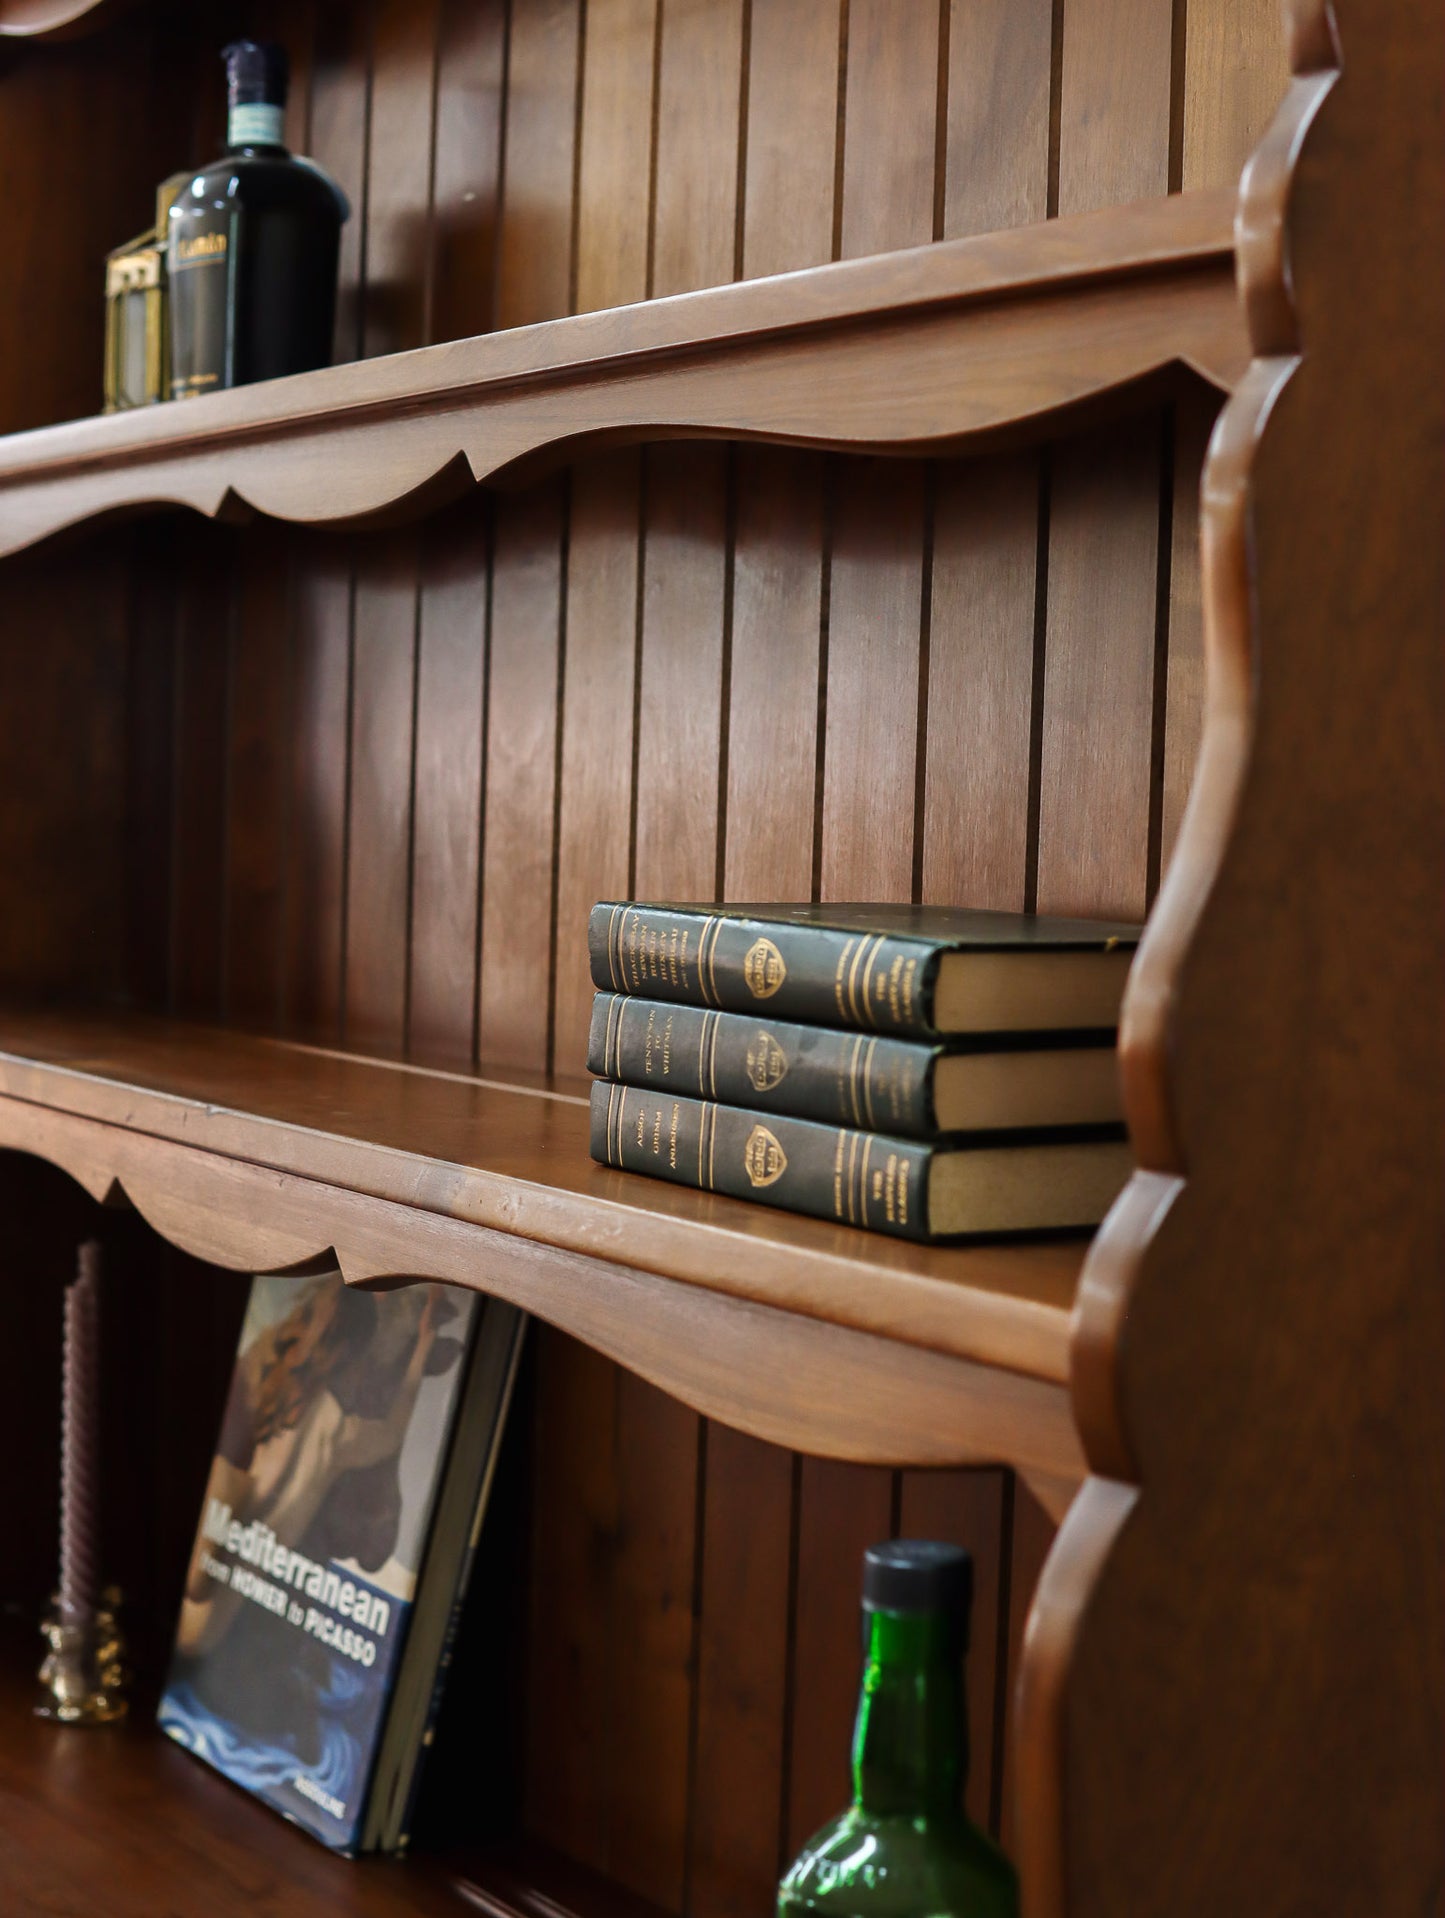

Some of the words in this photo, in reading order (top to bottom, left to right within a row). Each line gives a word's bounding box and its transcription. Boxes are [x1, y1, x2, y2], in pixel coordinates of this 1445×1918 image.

[640, 925, 648, 979] NEWMAN
[645, 1008, 655, 1073] TENNYSON
[664, 1015, 673, 1074] WHITMAN
[653, 1111, 662, 1154] GRIMM
[202, 1499, 390, 1635] Mediterranean
[231, 1564, 288, 1617] HOMER
[289, 1602, 305, 1625] to
[304, 1611, 376, 1667] PICASSO
